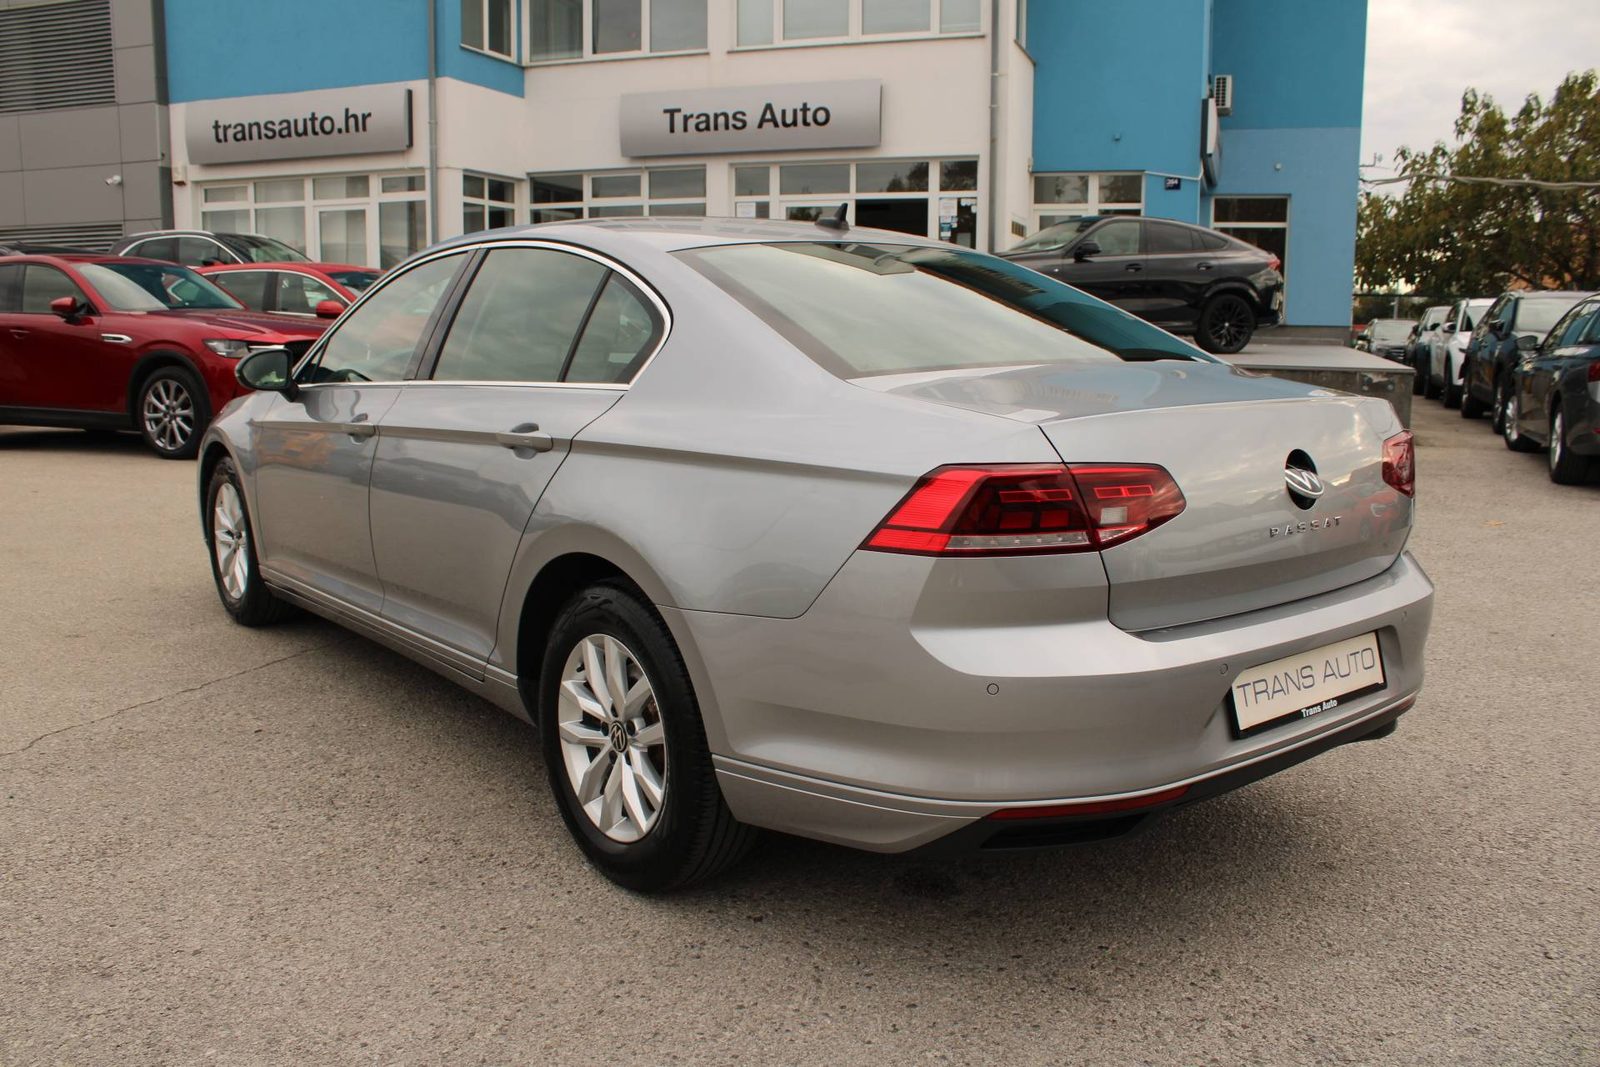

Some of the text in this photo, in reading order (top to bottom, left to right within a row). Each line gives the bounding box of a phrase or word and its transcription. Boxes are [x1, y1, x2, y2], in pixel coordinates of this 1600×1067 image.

[212, 108, 372, 144] transauto.hr
[663, 102, 831, 134] Trans Auto
[1269, 515, 1342, 538] PASSAT
[1236, 647, 1375, 708] TRANS AUTO
[1301, 698, 1338, 718] Trans Auto
